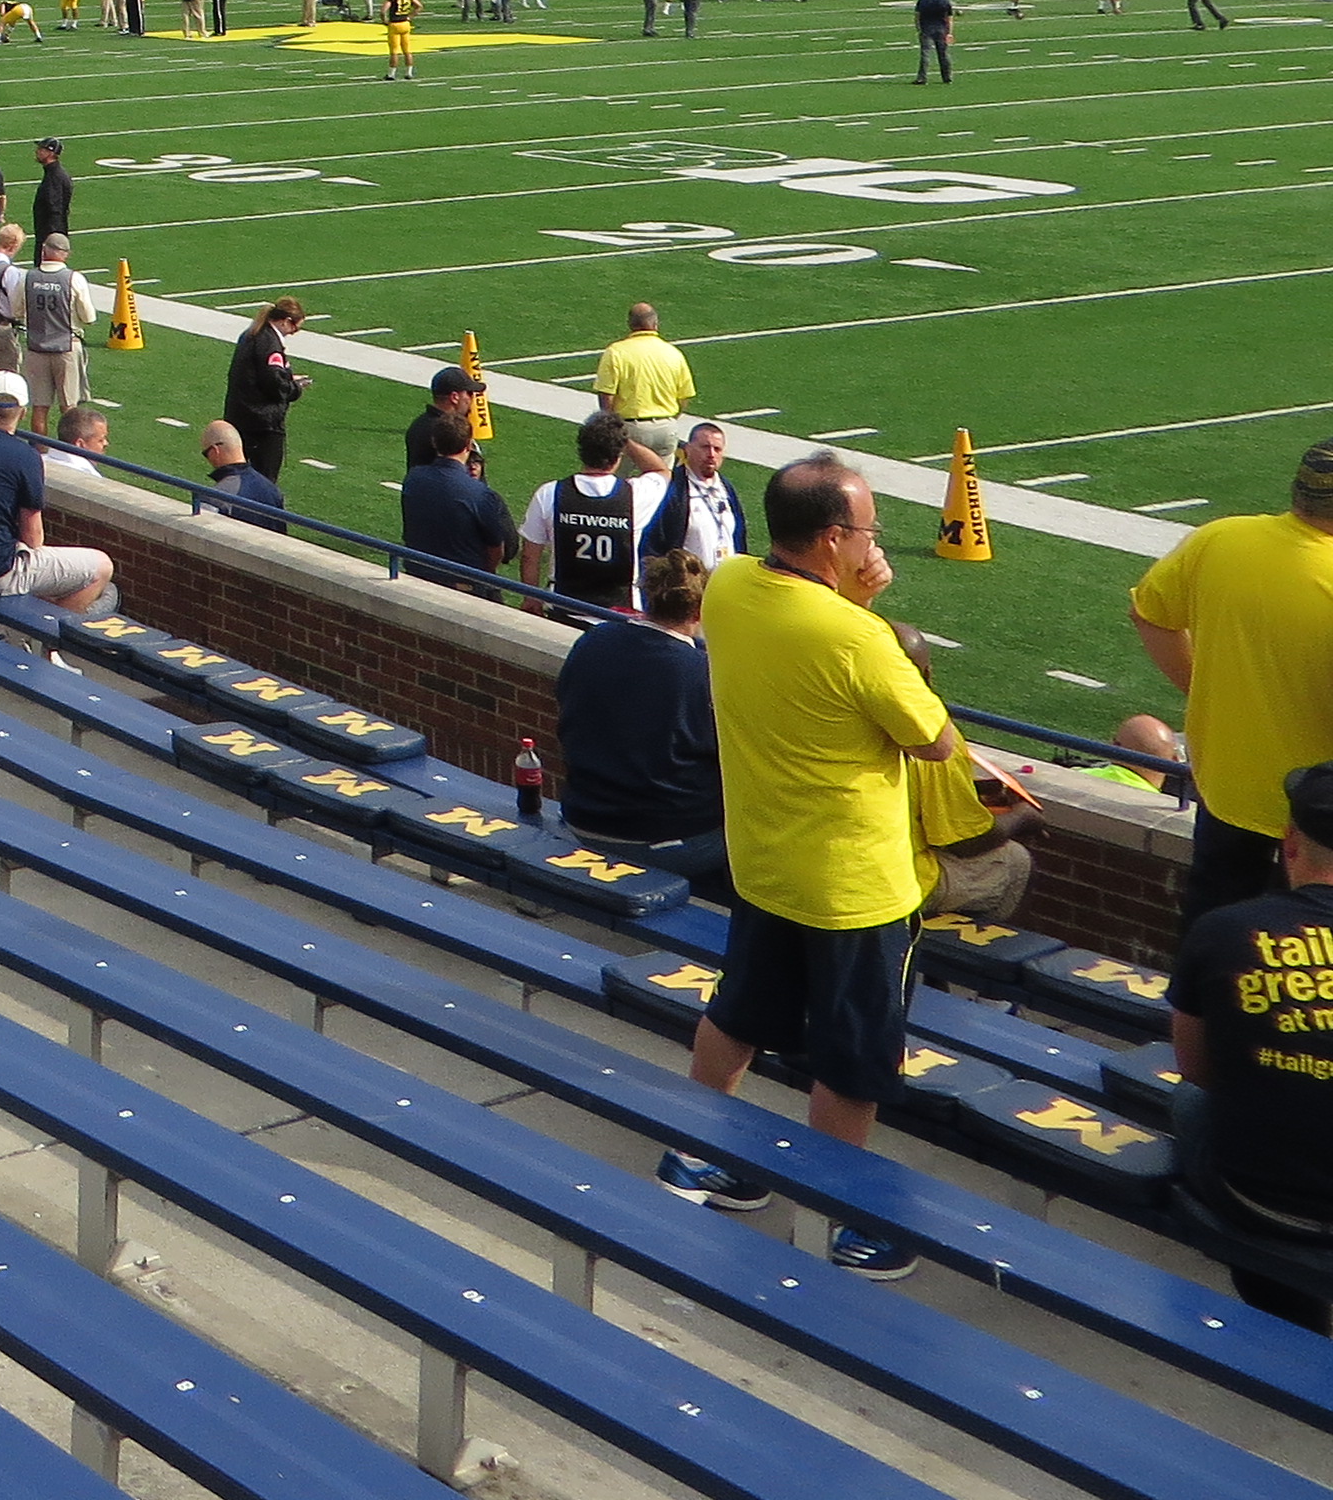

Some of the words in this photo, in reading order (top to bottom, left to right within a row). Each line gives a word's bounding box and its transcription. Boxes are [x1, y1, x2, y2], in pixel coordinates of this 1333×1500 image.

[395, 0, 412, 16] 12
[95, 153, 322, 183] 30
[538, 221, 880, 266] 20
[33, 282, 62, 292] PHOTO
[36, 293, 57, 312] 93
[123, 275, 142, 340] MICHIGAN
[109, 321, 128, 341] M
[962, 453, 985, 546] MICHIGAN
[559, 512, 629, 530] NETWORK
[937, 517, 965, 546] M
[574, 533, 614, 562] 20
[81, 616, 147, 639] M
[158, 646, 227, 668] M
[232, 676, 306, 701] M
[317, 710, 395, 736] M
[201, 729, 281, 757] M
[302, 768, 391, 797] M
[424, 806, 520, 838] M
[545, 848, 647, 882] M
[922, 912, 1019, 946] M
[1071, 958, 1171, 1000] M
[1276, 1007, 1312, 1033] at
[1014, 1097, 1158, 1156] M
[175, 1380, 195, 1392] 8
